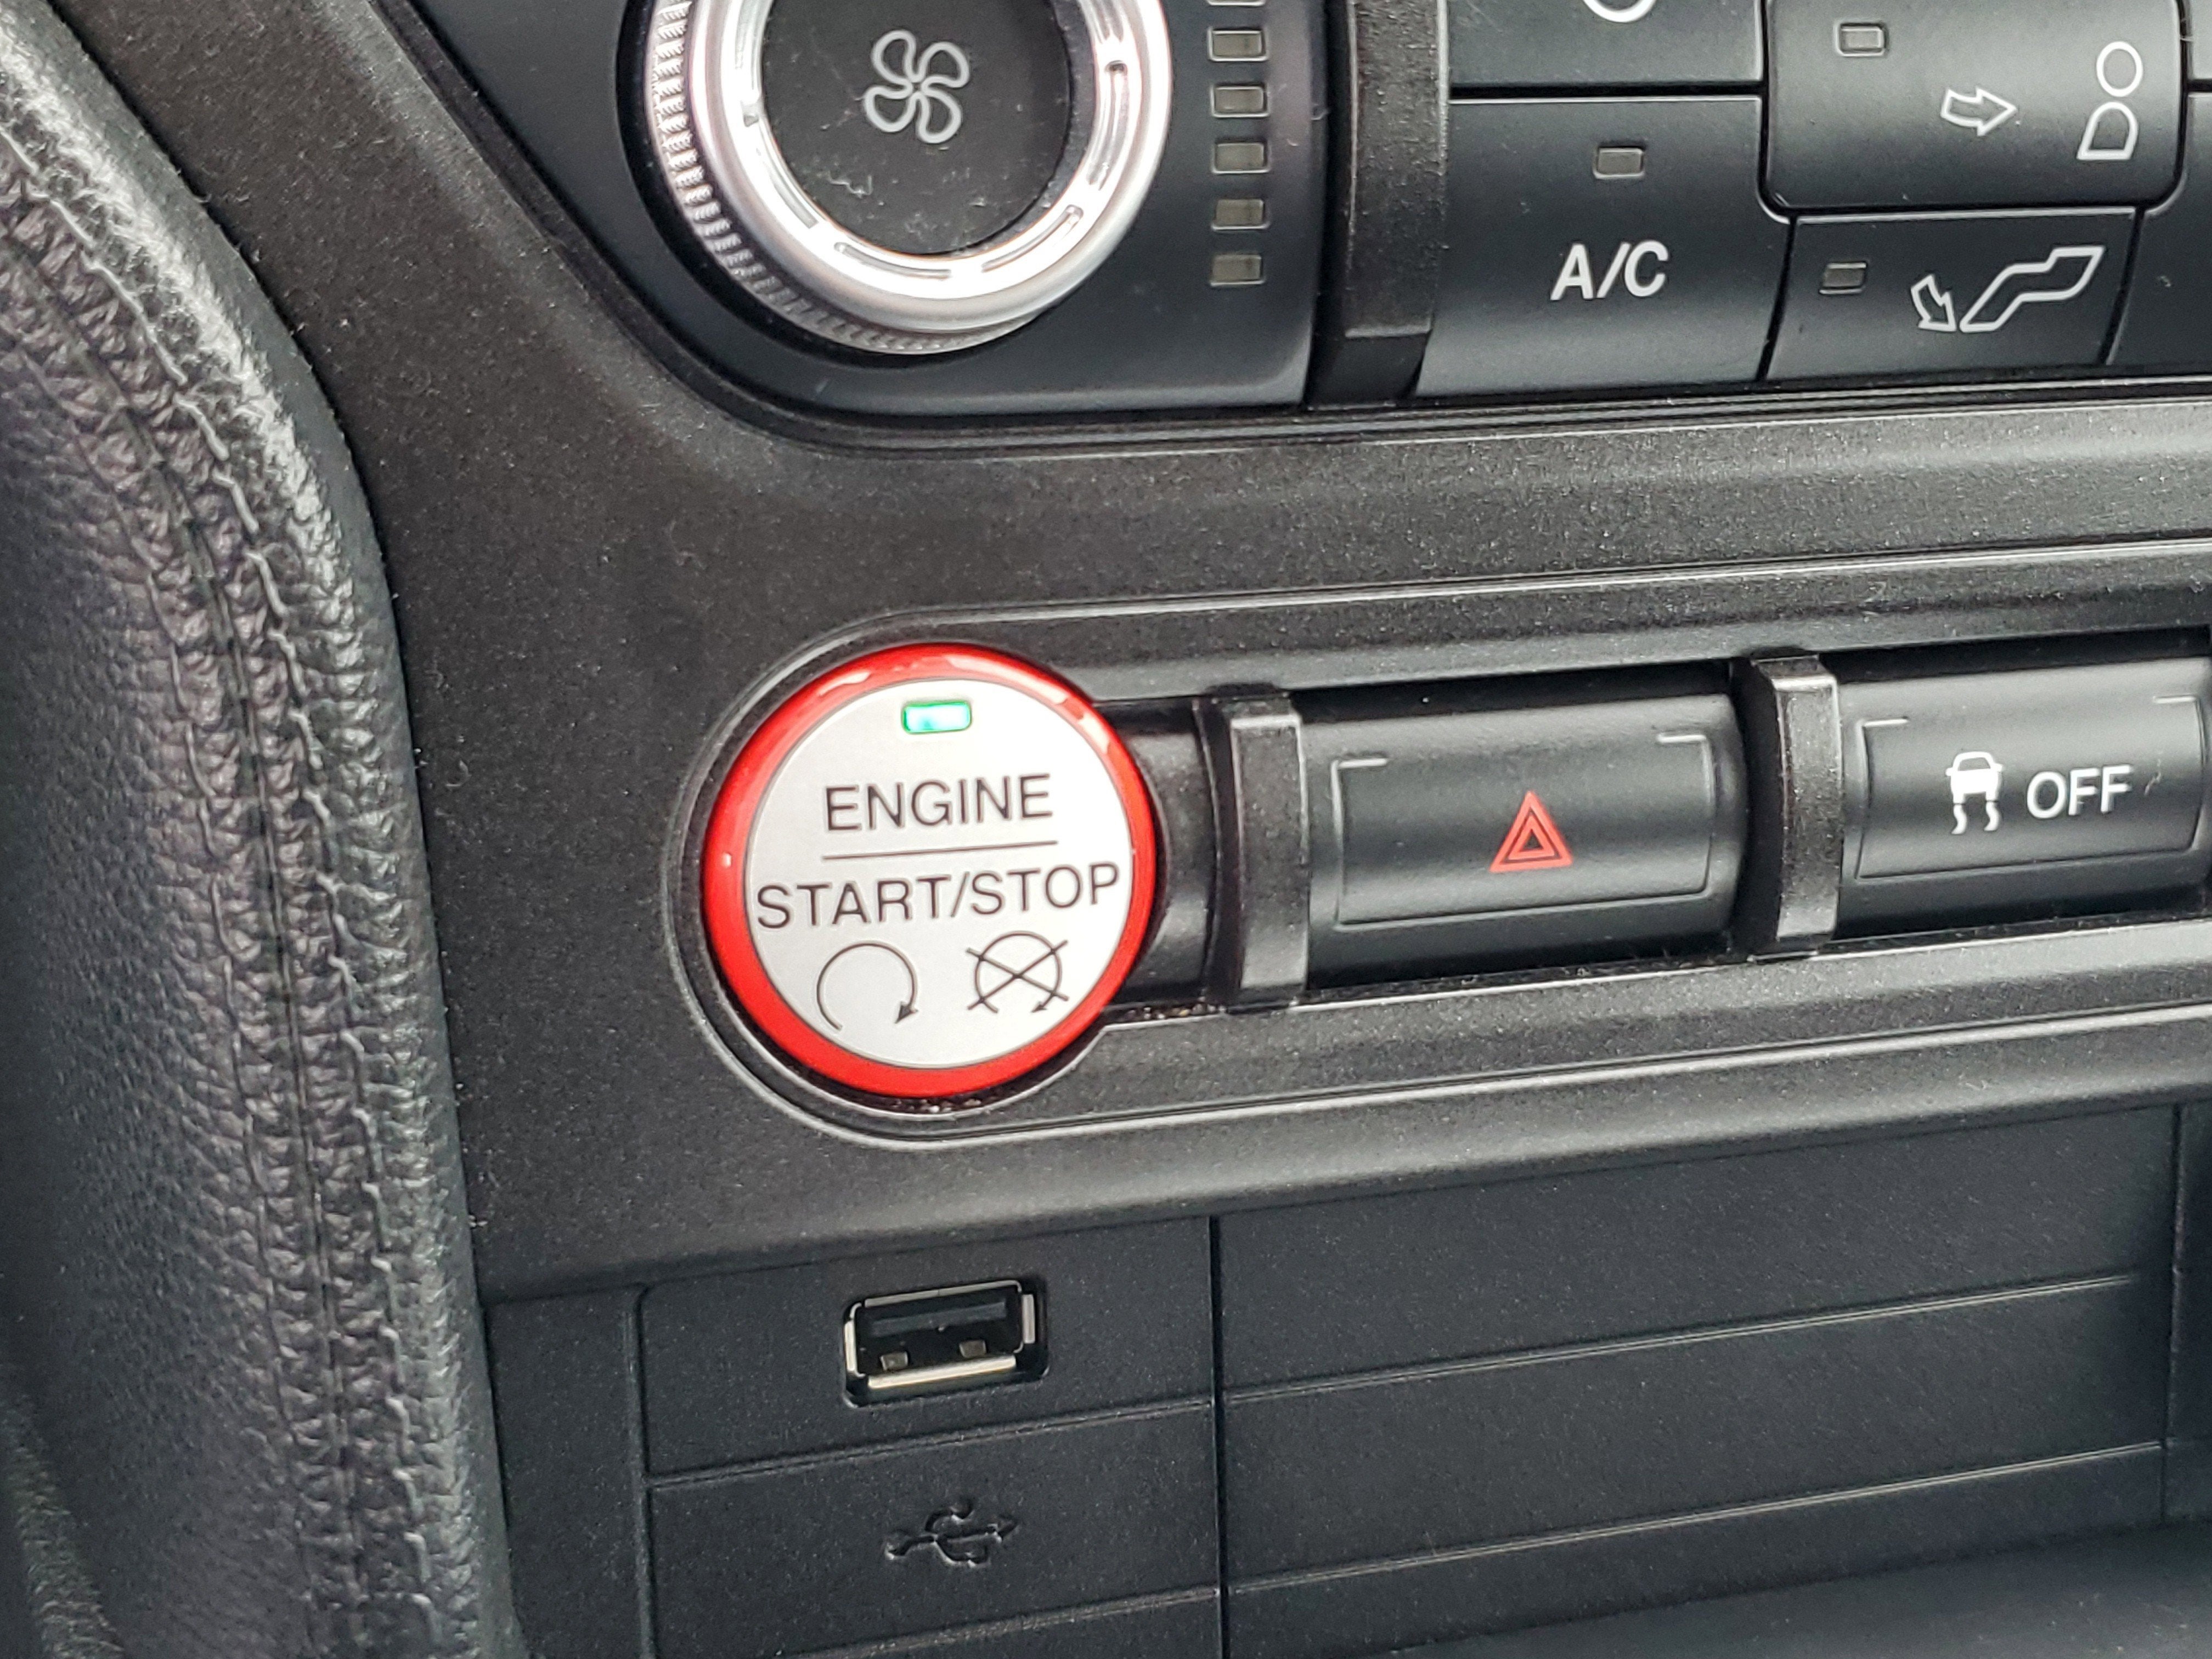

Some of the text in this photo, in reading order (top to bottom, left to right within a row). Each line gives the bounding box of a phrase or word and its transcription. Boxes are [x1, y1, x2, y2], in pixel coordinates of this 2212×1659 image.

[1551, 241, 1668, 301] A/C
[825, 773, 1053, 831] ENGINE
[2027, 765, 2133, 819] OFF
[757, 862, 1120, 930] START/STOP
